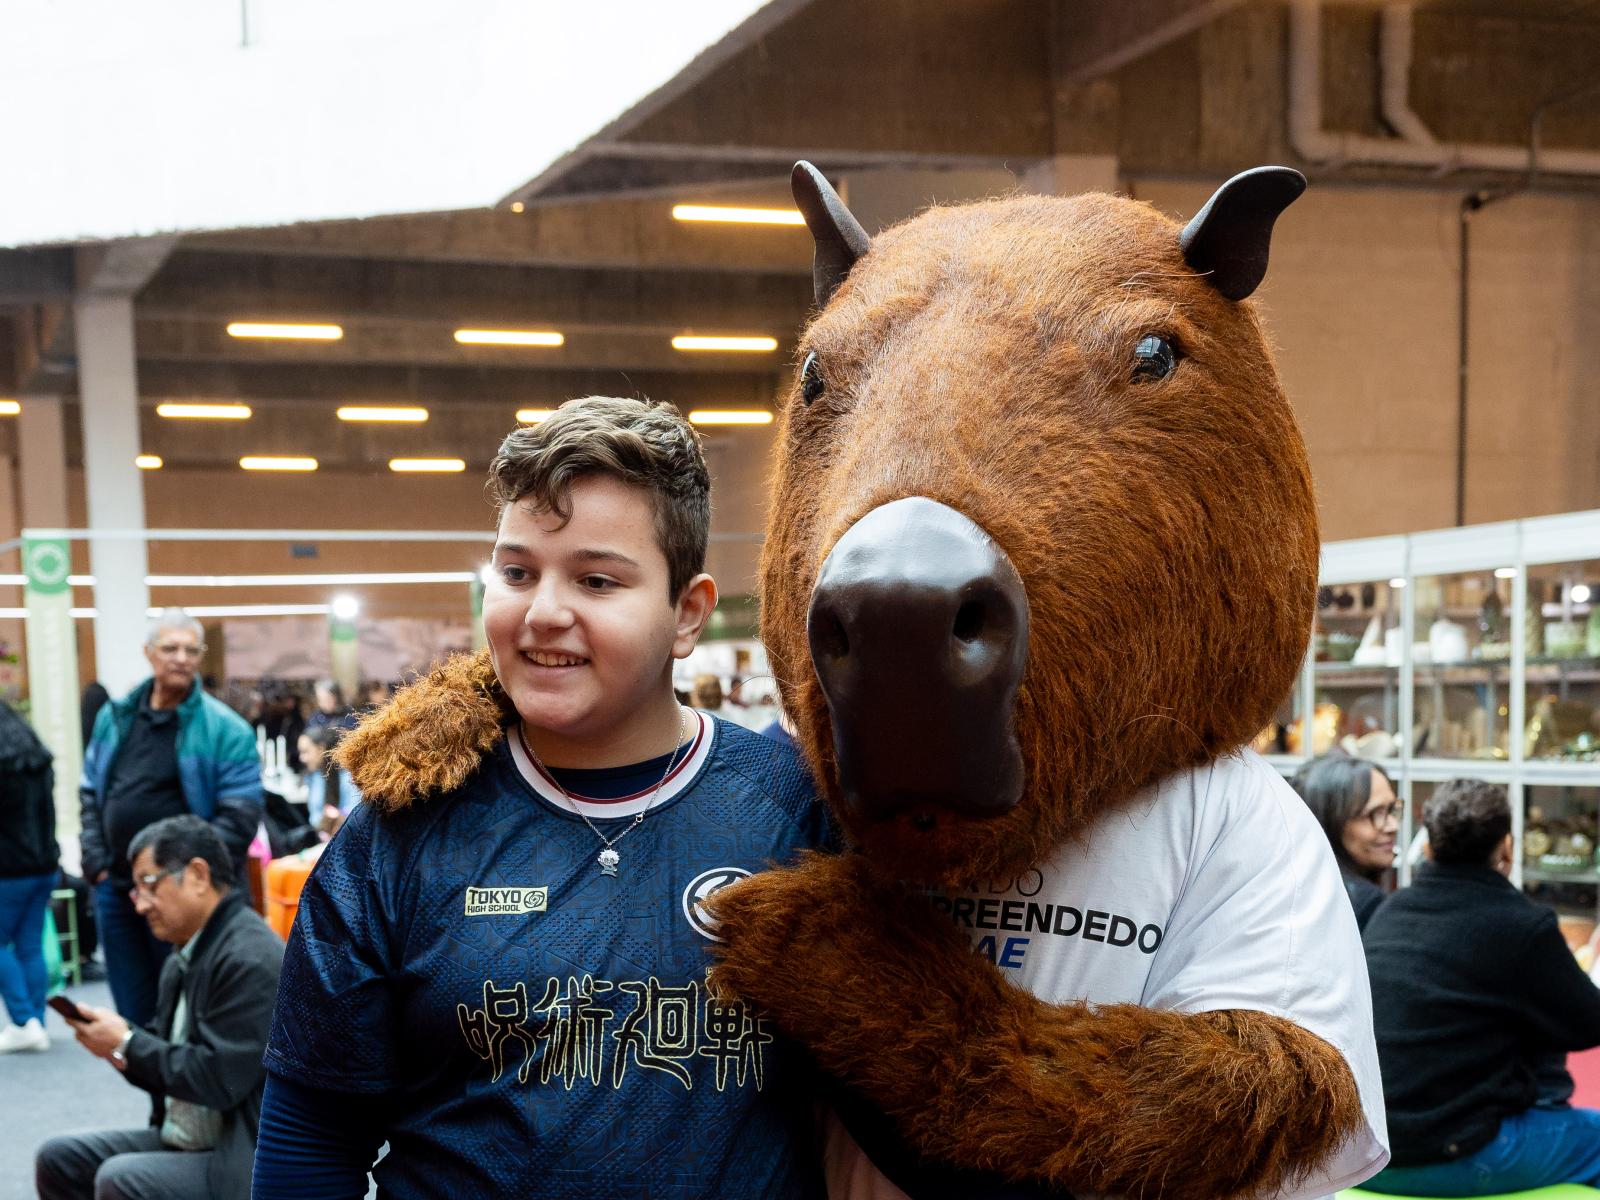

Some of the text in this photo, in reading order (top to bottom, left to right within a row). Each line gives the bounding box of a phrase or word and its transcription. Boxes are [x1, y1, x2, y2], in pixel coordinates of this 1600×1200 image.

[468, 889, 522, 905] TOKYO
[467, 904, 521, 914] HIGH SCHOOL
